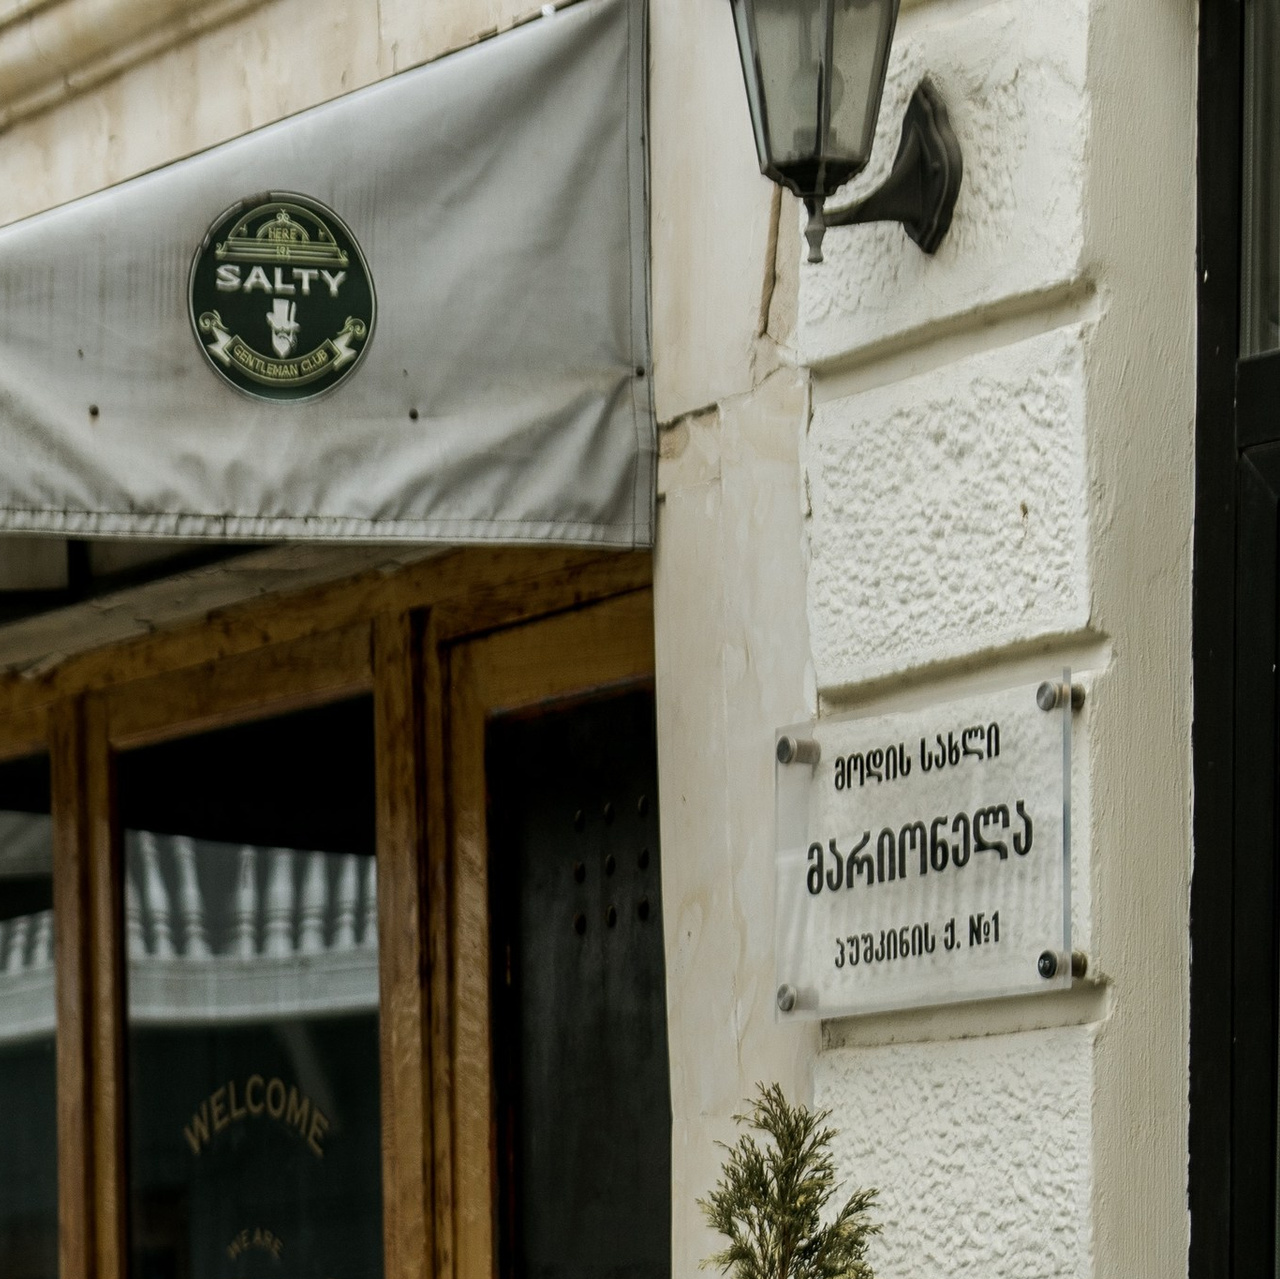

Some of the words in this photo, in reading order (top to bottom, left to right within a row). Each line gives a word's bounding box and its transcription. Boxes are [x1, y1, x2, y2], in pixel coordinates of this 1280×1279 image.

[215, 263, 346, 297] SALTY
[233, 344, 299, 377] GENTLEMAN
[300, 349, 329, 373] CLUB
[833, 741, 912, 791] მოდის
[920, 721, 1001, 772] სახლი
[806, 799, 1033, 895] მარიონელა
[834, 921, 936, 969] პუშკინის
[183, 1073, 331, 1157] WELCOME
[226, 1228, 250, 1262] WE
[251, 1226, 284, 1264] ARE
